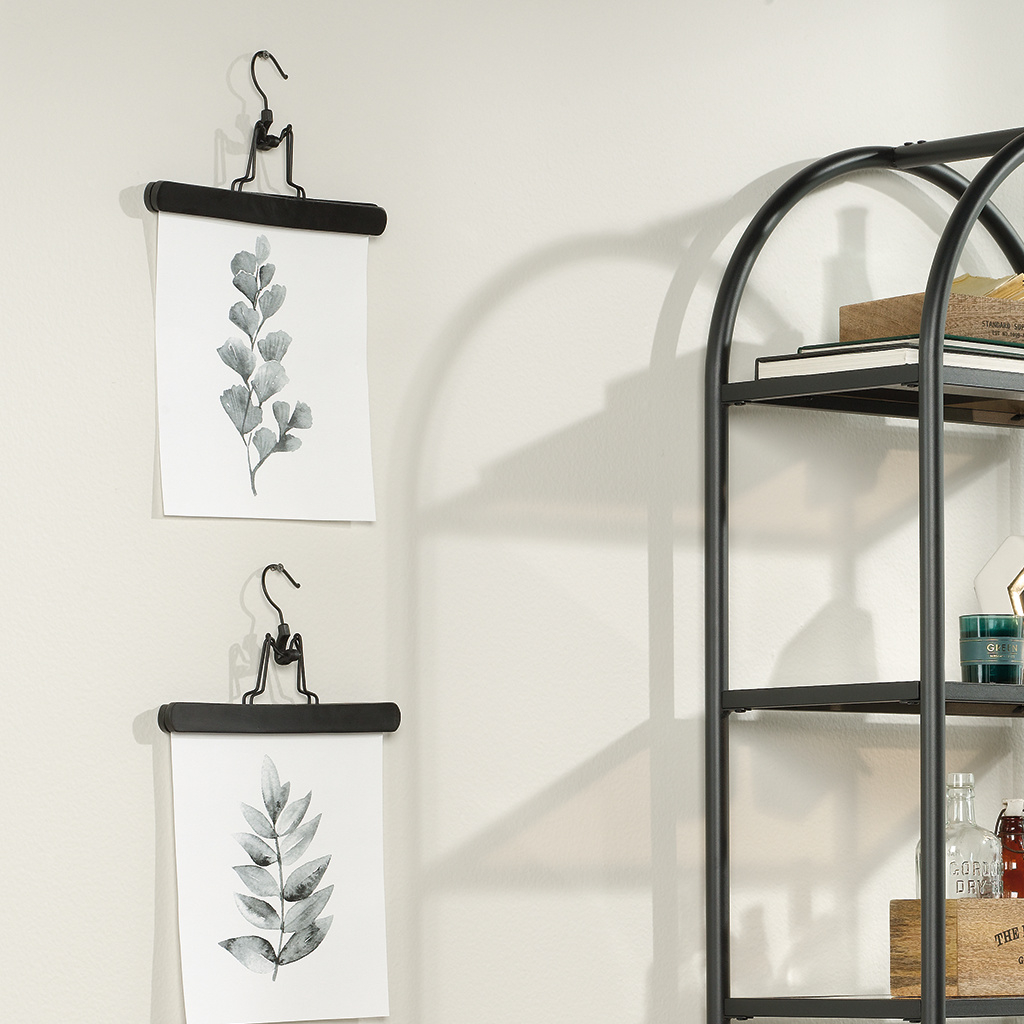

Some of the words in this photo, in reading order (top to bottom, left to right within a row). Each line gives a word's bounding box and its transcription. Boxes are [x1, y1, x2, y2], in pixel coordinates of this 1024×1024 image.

[981, 320, 1011, 330] STANDARD
[986, 643, 1018, 652] GREEN
[956, 879, 988, 895] DRY
[994, 927, 1020, 947] THE
